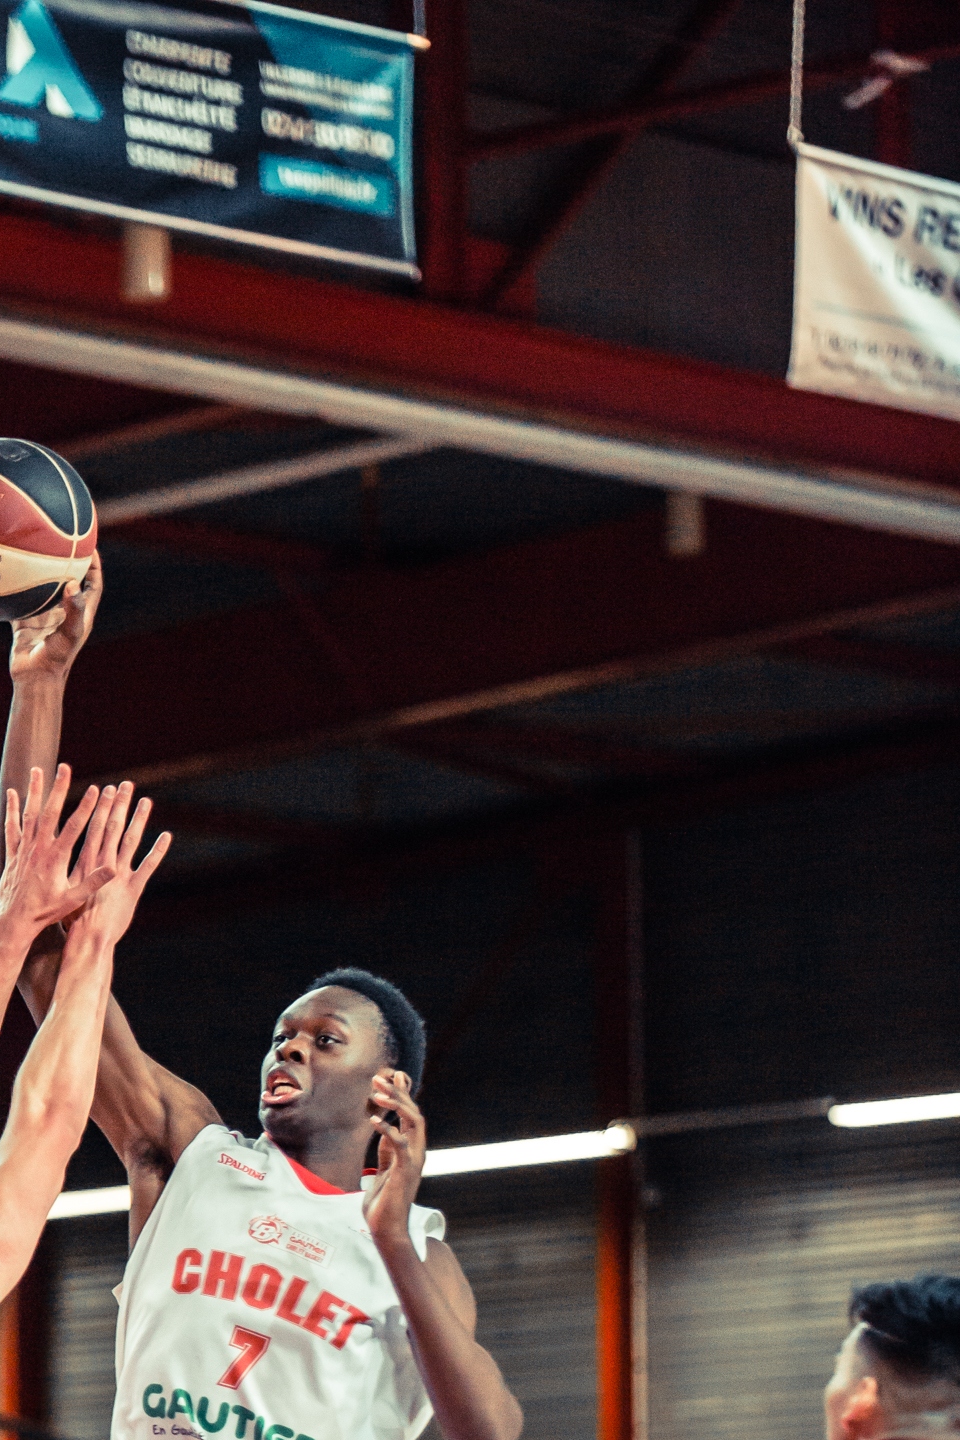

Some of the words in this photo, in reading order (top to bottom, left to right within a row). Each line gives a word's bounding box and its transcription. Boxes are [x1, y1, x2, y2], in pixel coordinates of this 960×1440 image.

[217, 1152, 267, 1181] SPALDING
[171, 1247, 374, 1351] CHOLET
[216, 1324, 272, 1391] 7
